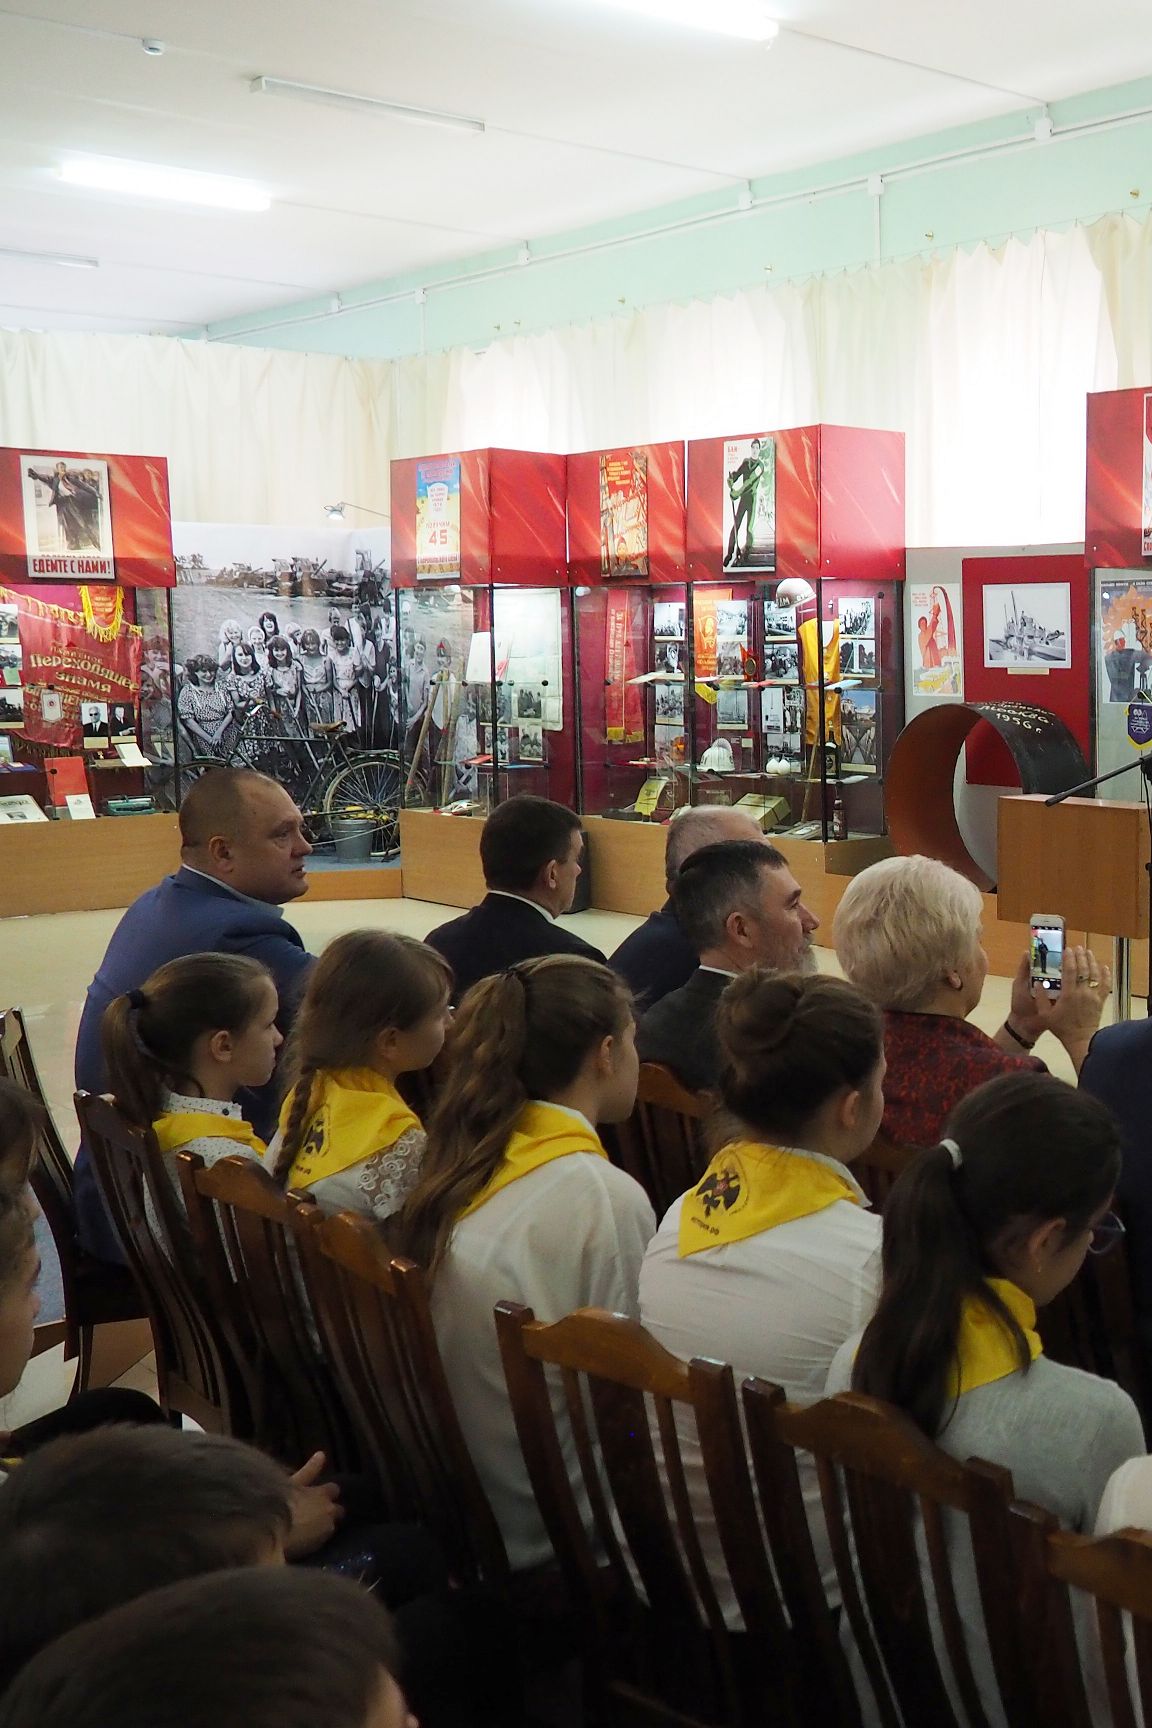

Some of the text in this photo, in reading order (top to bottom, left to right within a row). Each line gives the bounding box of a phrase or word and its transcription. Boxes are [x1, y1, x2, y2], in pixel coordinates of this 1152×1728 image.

[428, 529, 448, 546] 45
[77, 560, 111, 574] НАМИ!
[996, 713, 1032, 729] 1956
